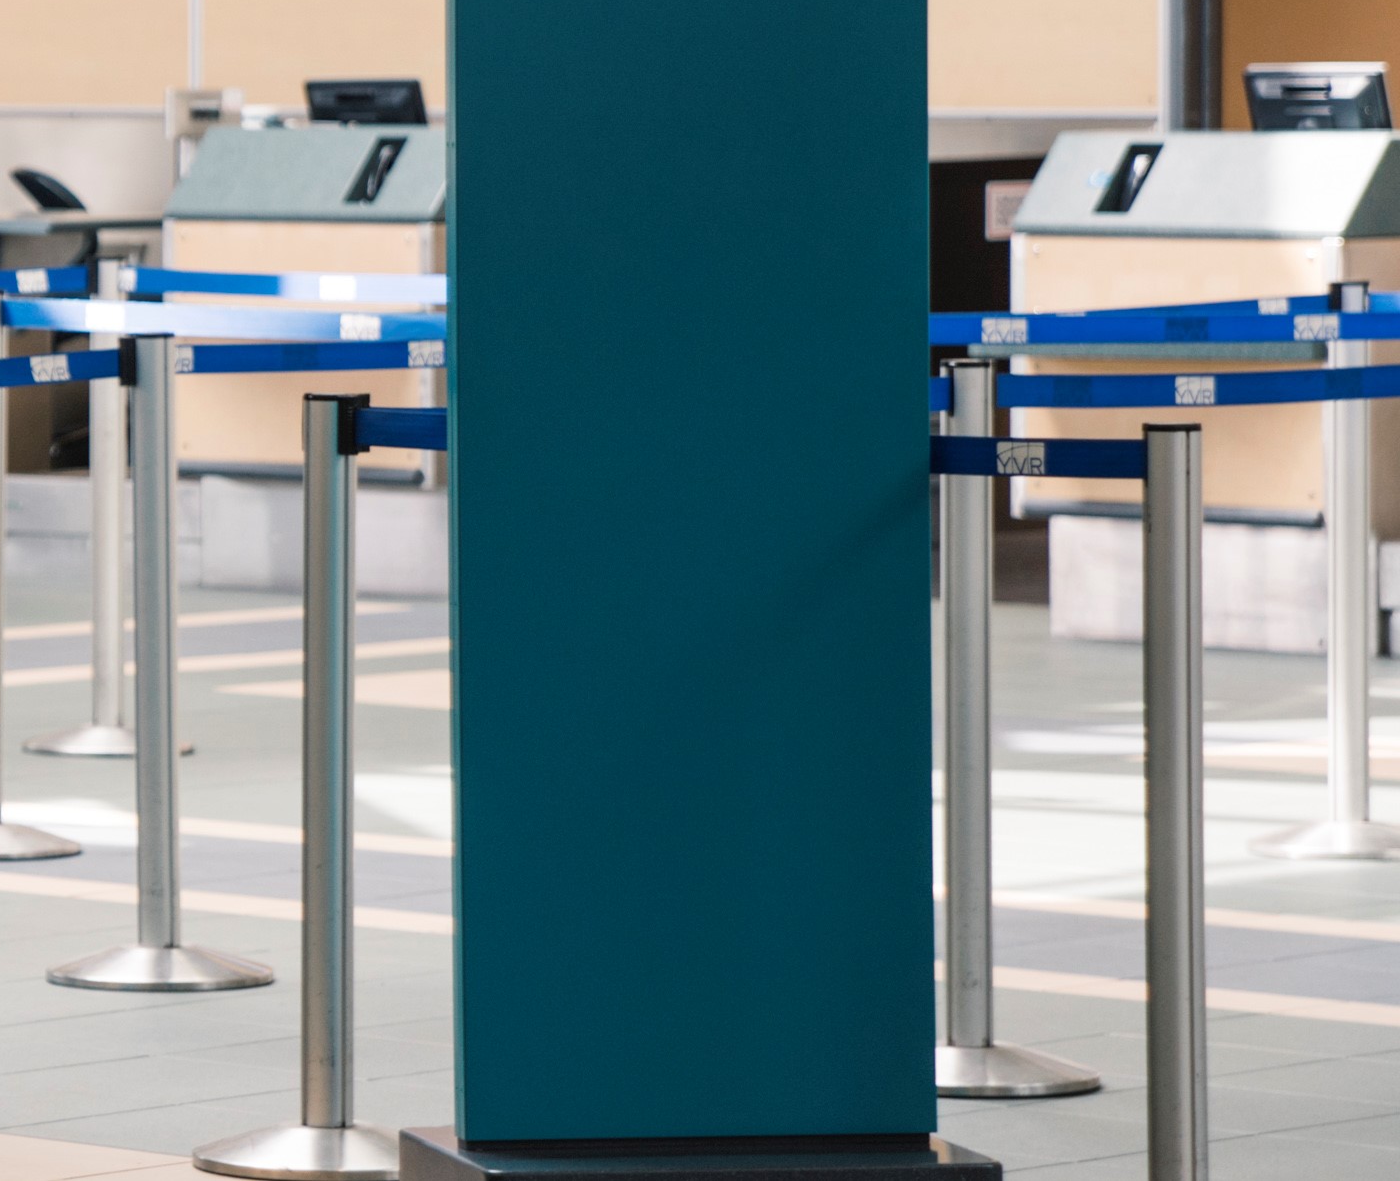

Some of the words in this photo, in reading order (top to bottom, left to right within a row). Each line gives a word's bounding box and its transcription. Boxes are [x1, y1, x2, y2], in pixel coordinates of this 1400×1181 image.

[982, 330, 1026, 343] YVR
[1294, 328, 1338, 341] YVR
[408, 351, 444, 367] YVR
[31, 366, 70, 382] YVR
[1175, 389, 1214, 405] YVR
[997, 457, 1044, 475] YVR
